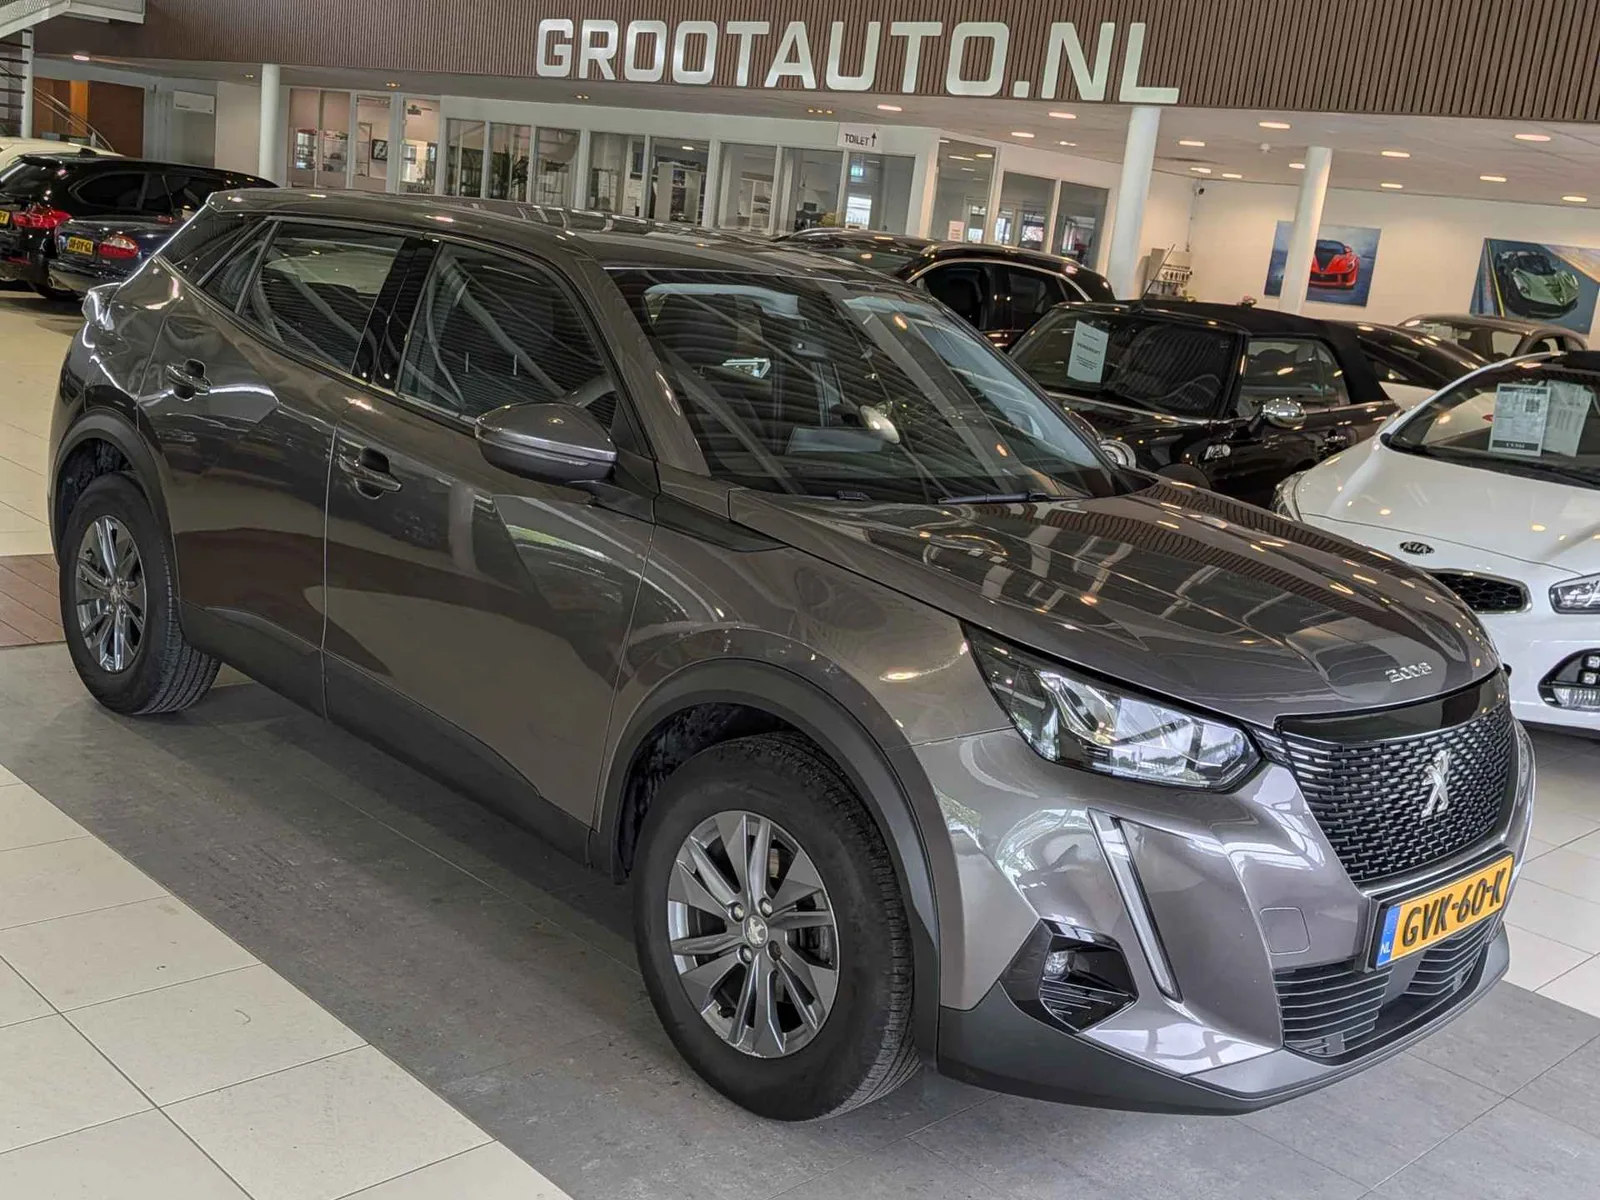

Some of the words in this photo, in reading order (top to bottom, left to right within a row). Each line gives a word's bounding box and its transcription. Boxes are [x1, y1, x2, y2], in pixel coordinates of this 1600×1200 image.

[536, 18, 1179, 104] GROOTAUTO.NL
[845, 133, 870, 147] TOILET
[1385, 662, 1432, 683] 2008
[1402, 867, 1507, 947] GVK-60-K
[1380, 941, 1391, 954] NL
